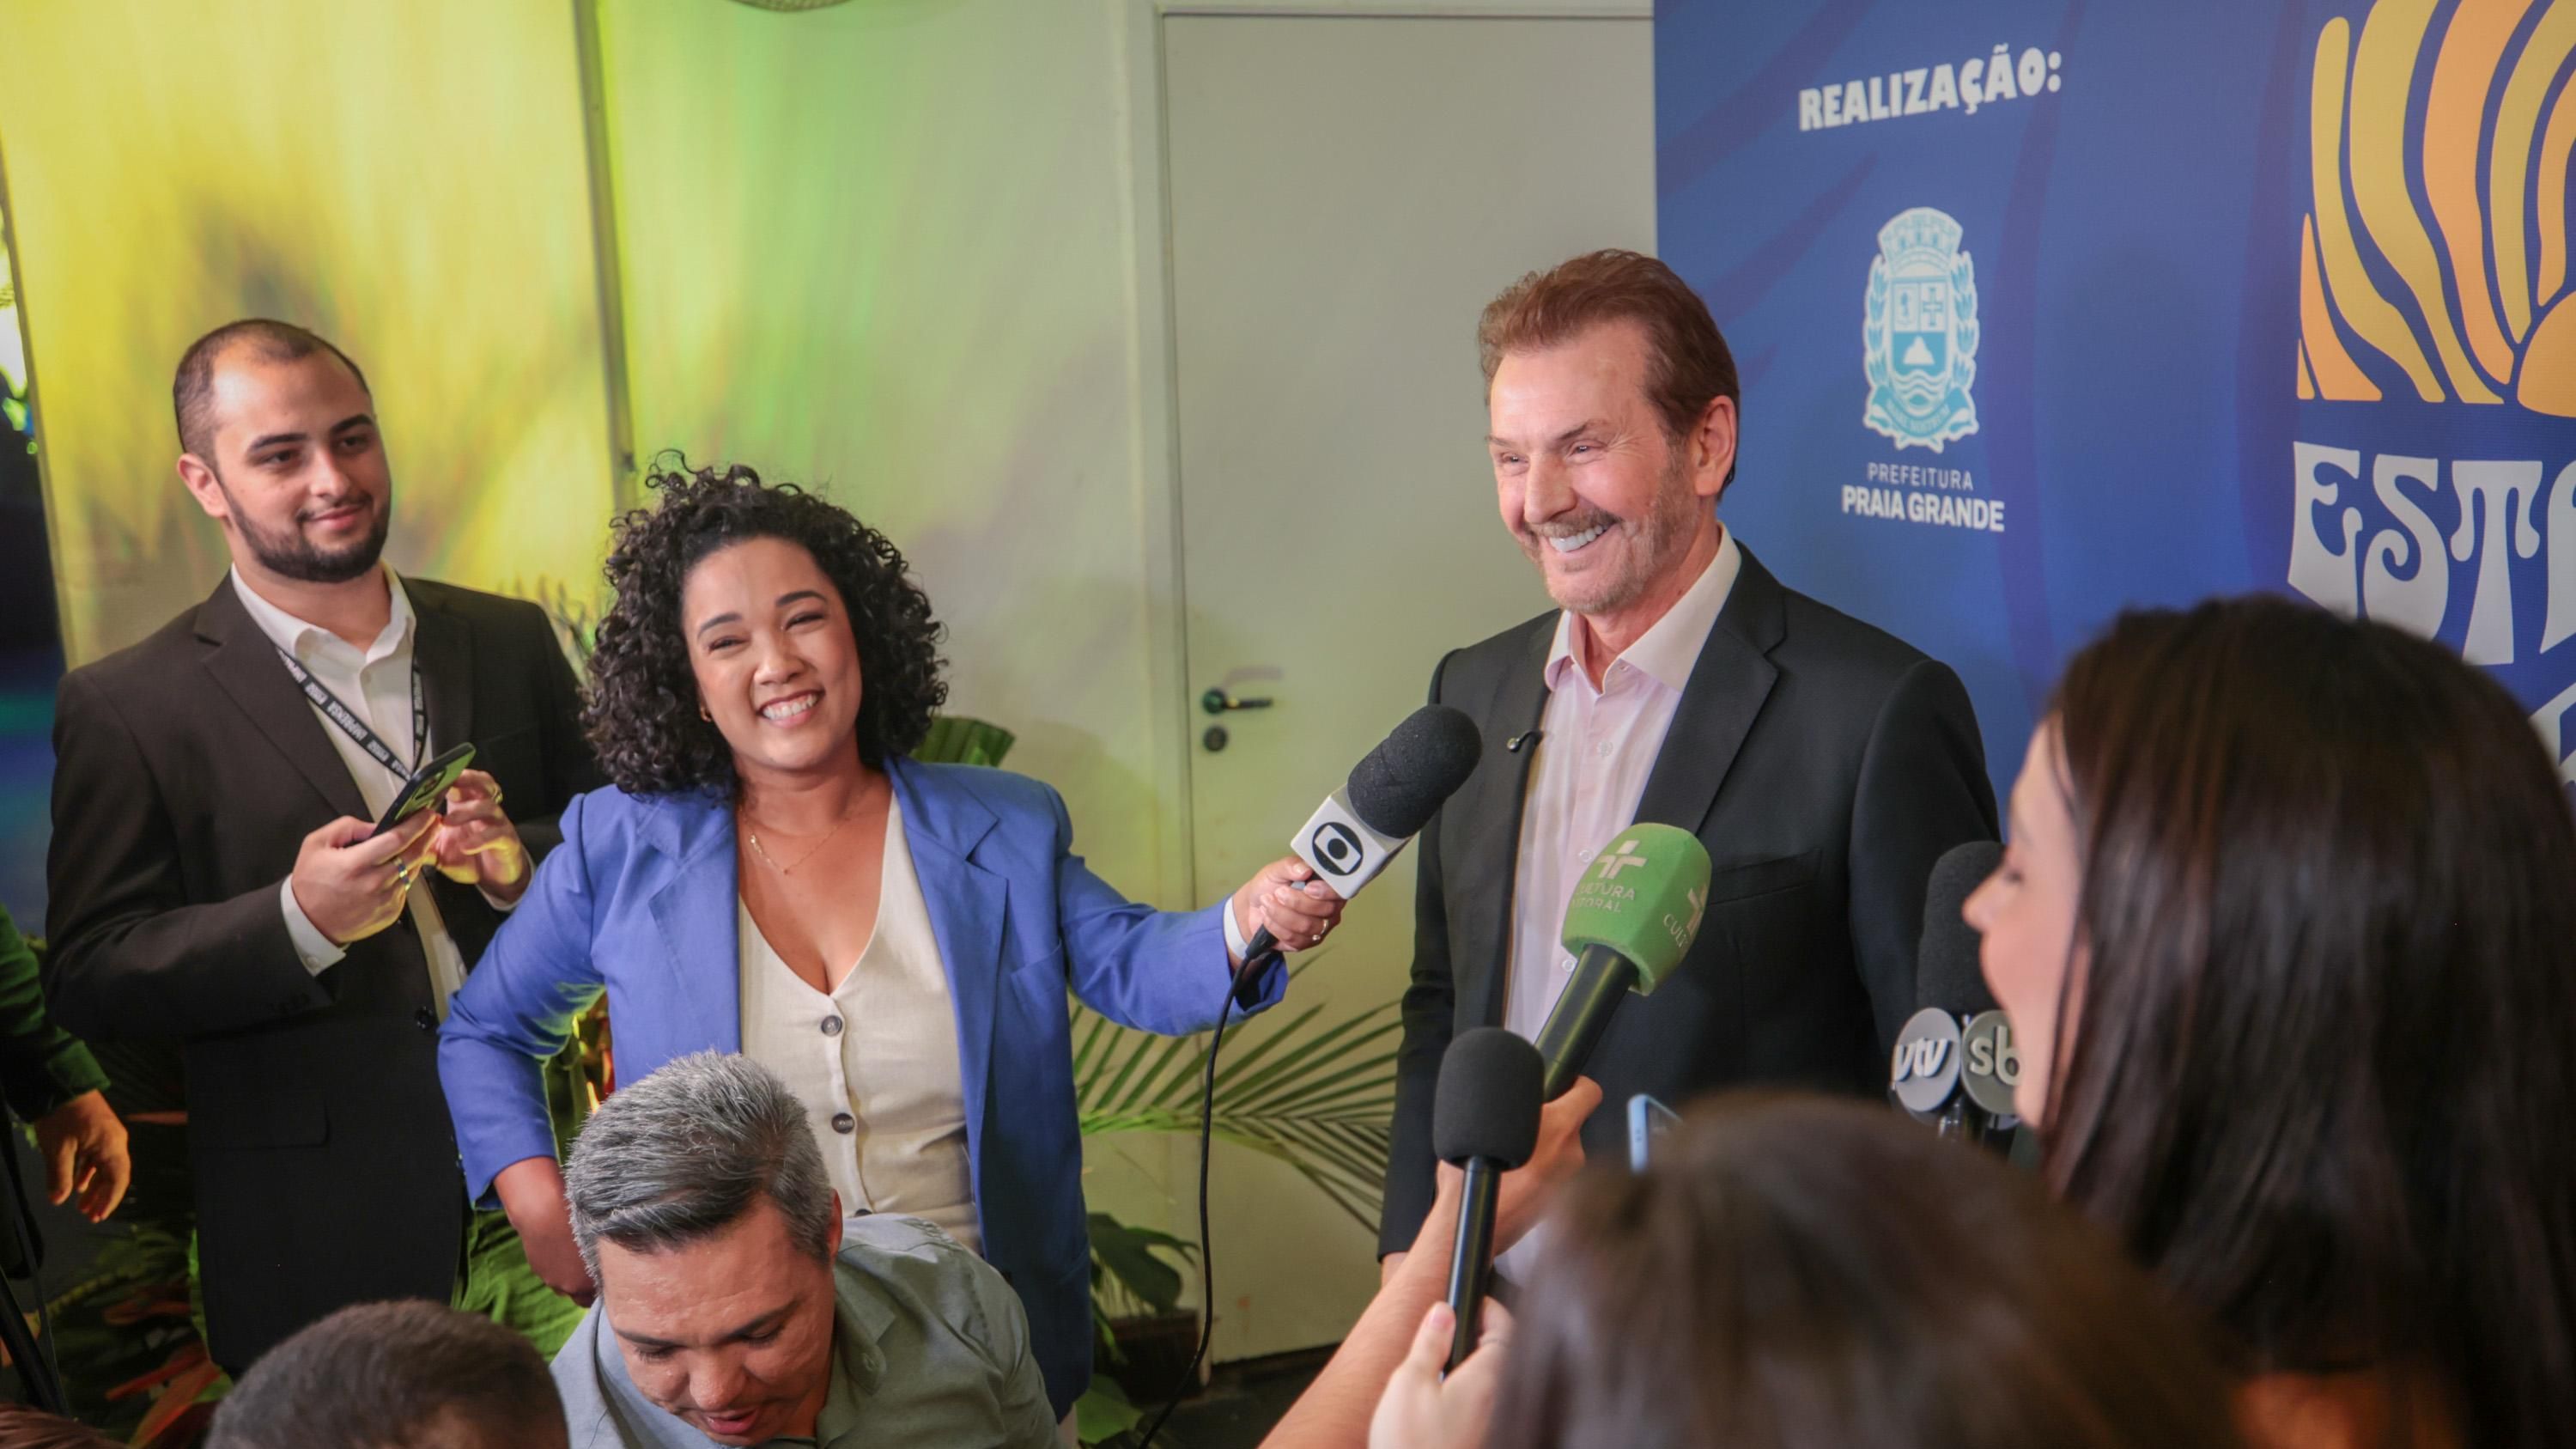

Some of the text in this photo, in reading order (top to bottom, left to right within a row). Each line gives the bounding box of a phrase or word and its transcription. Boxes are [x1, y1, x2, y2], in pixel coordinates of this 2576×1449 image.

[1799, 43, 2063, 131] REALIZAÇÃO:
[1867, 462, 1974, 490] PREFEITURA
[1842, 484, 2005, 533] PRAIA GRANDE
[1577, 882, 1636, 901] ULTURA
